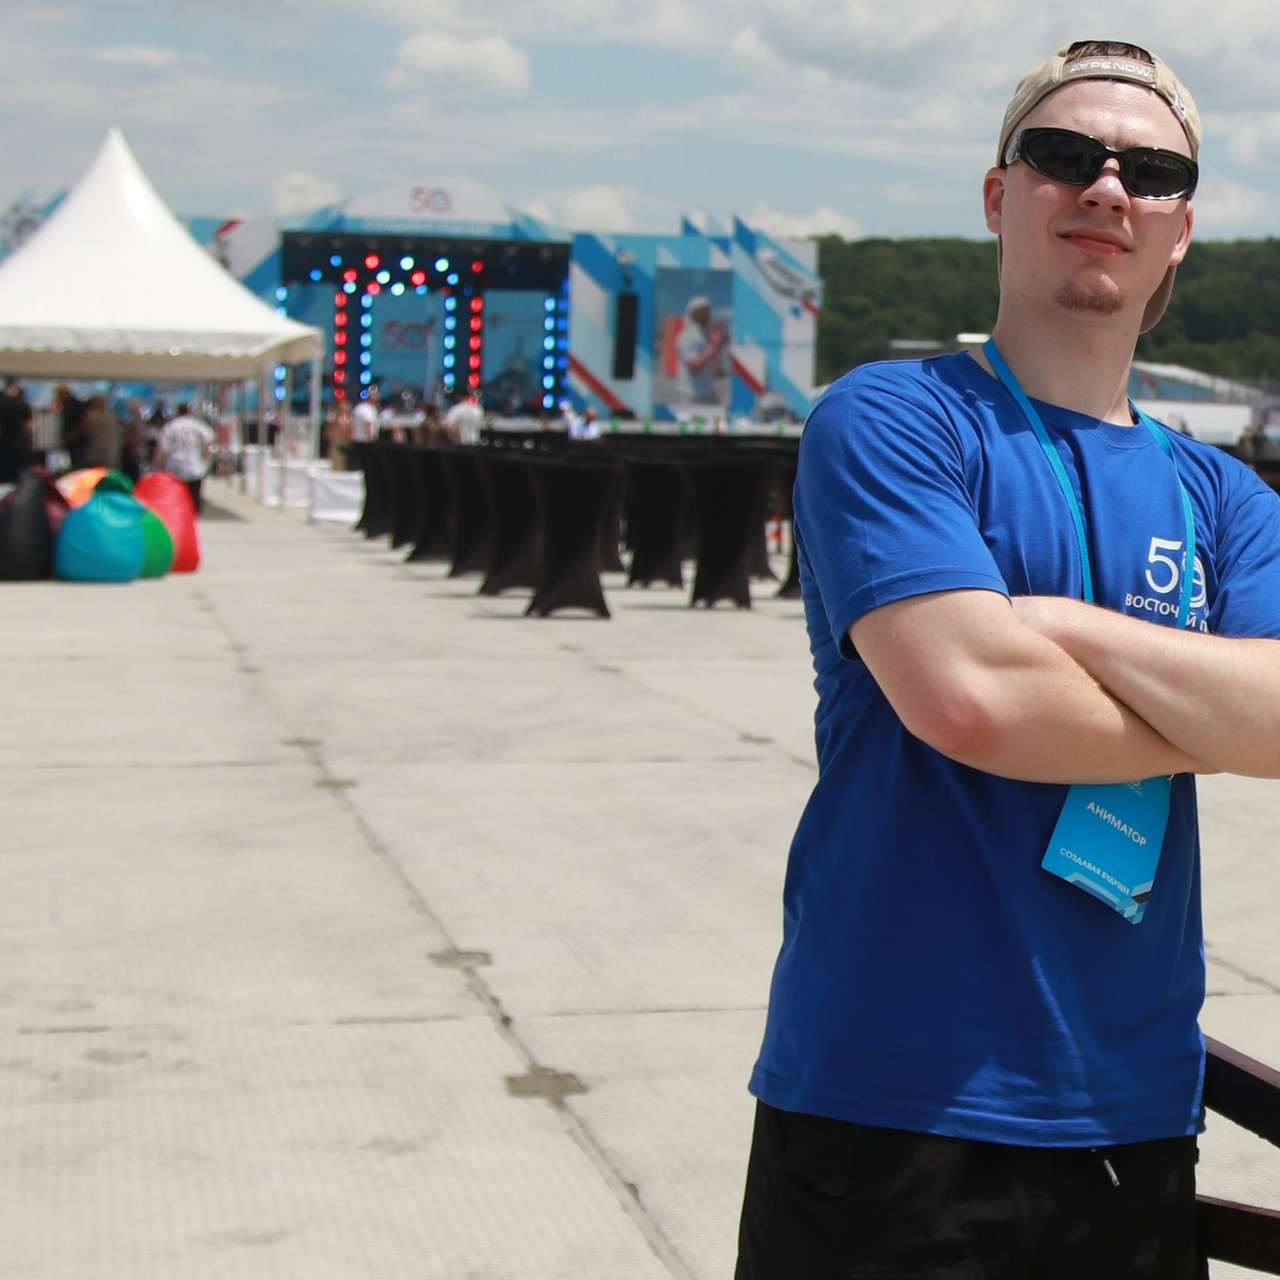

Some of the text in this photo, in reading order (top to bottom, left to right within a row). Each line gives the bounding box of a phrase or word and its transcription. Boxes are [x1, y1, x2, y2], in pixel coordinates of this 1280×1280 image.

[1125, 592, 1197, 628] ВОСТОЧЙ
[1086, 801, 1147, 847] АНИМАТОР
[1060, 847, 1130, 896] СОЗДАВАЯ БУДУЩЕЕ
